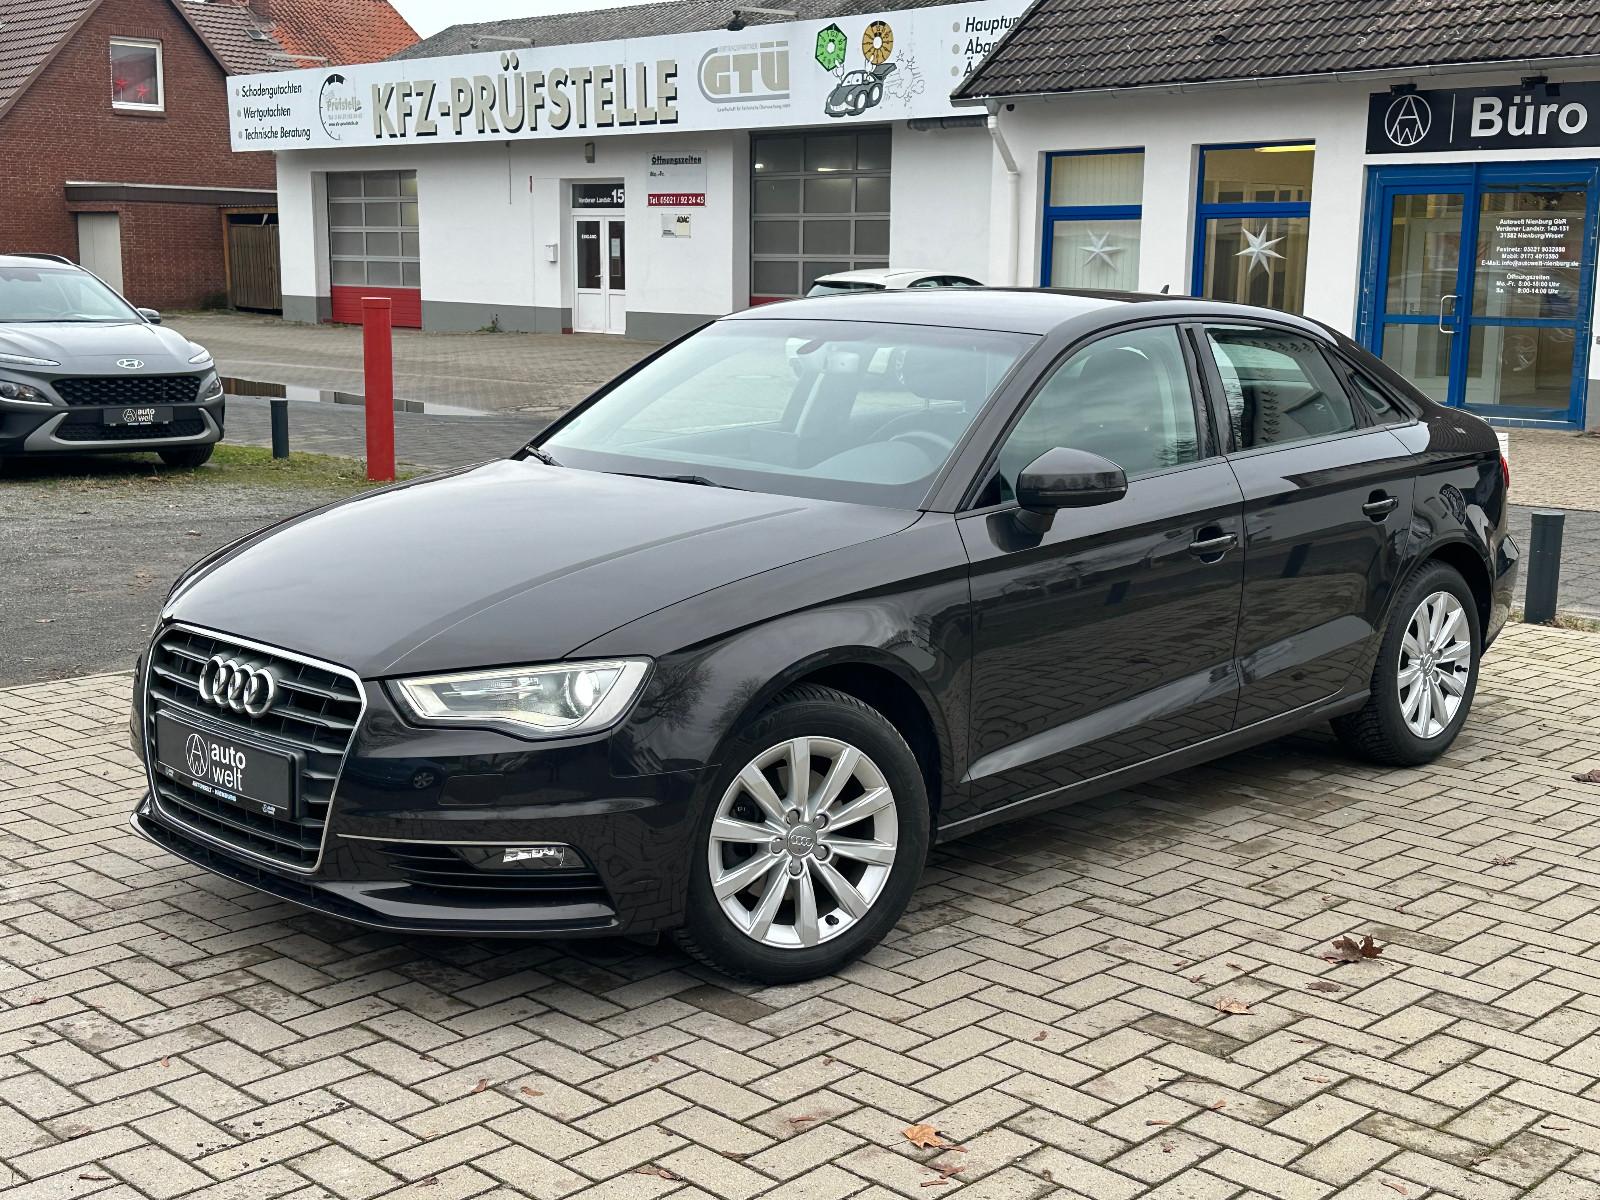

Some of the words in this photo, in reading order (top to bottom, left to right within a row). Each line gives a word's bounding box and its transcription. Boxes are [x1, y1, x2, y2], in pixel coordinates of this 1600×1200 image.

[703, 41, 789, 95] GTÜ
[241, 81, 302, 98] Schadengutachten
[371, 52, 678, 138] KFZ-PRÜFSTELLE
[244, 104, 291, 121] Wertgutachten
[1470, 96, 1588, 137] Büro
[245, 128, 278, 140] Technische
[280, 127, 311, 141] Beratung
[651, 154, 701, 165] Öffnungszeiten
[649, 196, 659, 204] Tel.
[681, 196, 688, 204] 92
[688, 196, 696, 204] 24
[697, 196, 704, 204] 45
[211, 743, 246, 770] auto
[212, 765, 243, 792] welt
